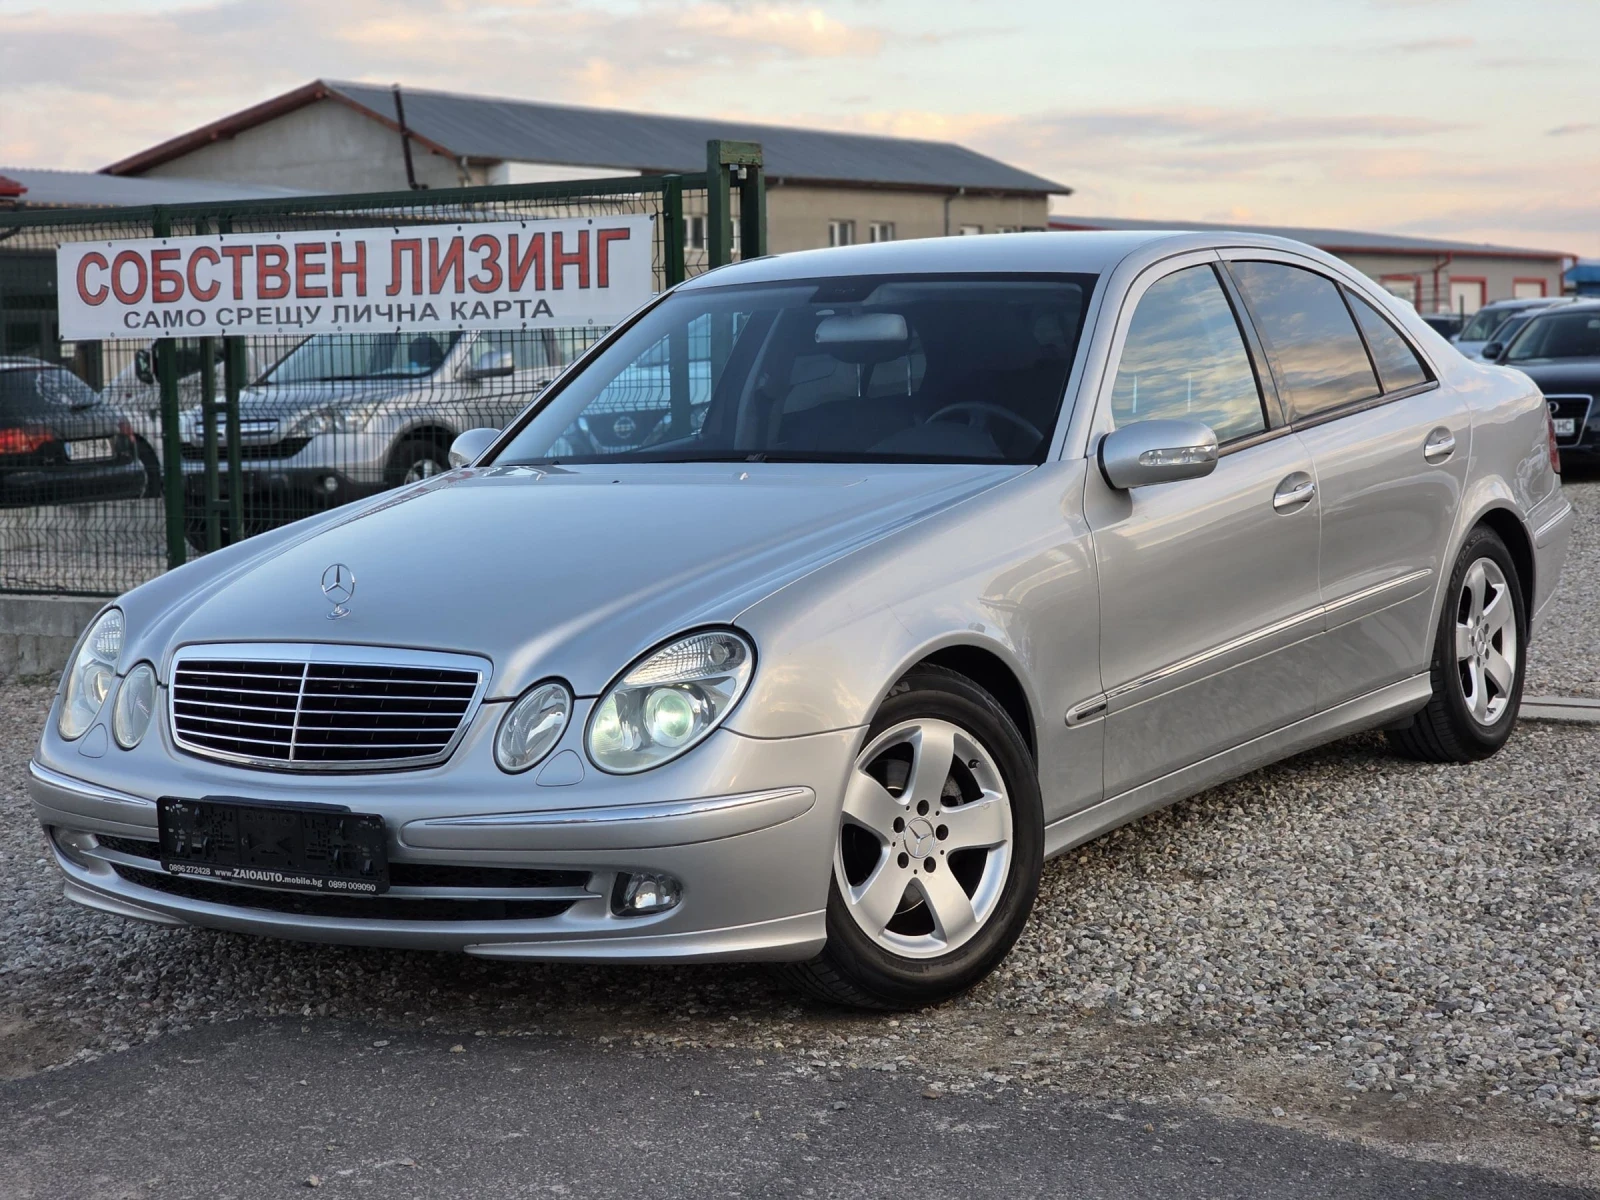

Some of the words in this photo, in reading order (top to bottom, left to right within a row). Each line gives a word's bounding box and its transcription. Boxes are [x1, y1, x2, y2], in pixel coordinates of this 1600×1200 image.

[76, 240, 368, 306] СОБСТВЕН
[385, 226, 631, 295] ЛИЗИНГ
[124, 308, 207, 330] САМО
[216, 304, 322, 326] СРЕЩУ
[332, 301, 441, 323] ЛИЧНА
[450, 298, 555, 320] КАРТА
[168, 864, 186, 872] 0896
[186, 865, 211, 875] 272428
[214, 868, 323, 888] www.ZAIOAUTO.mobile.bg
[327, 880, 347, 889] 0899
[347, 882, 376, 892] 009090
